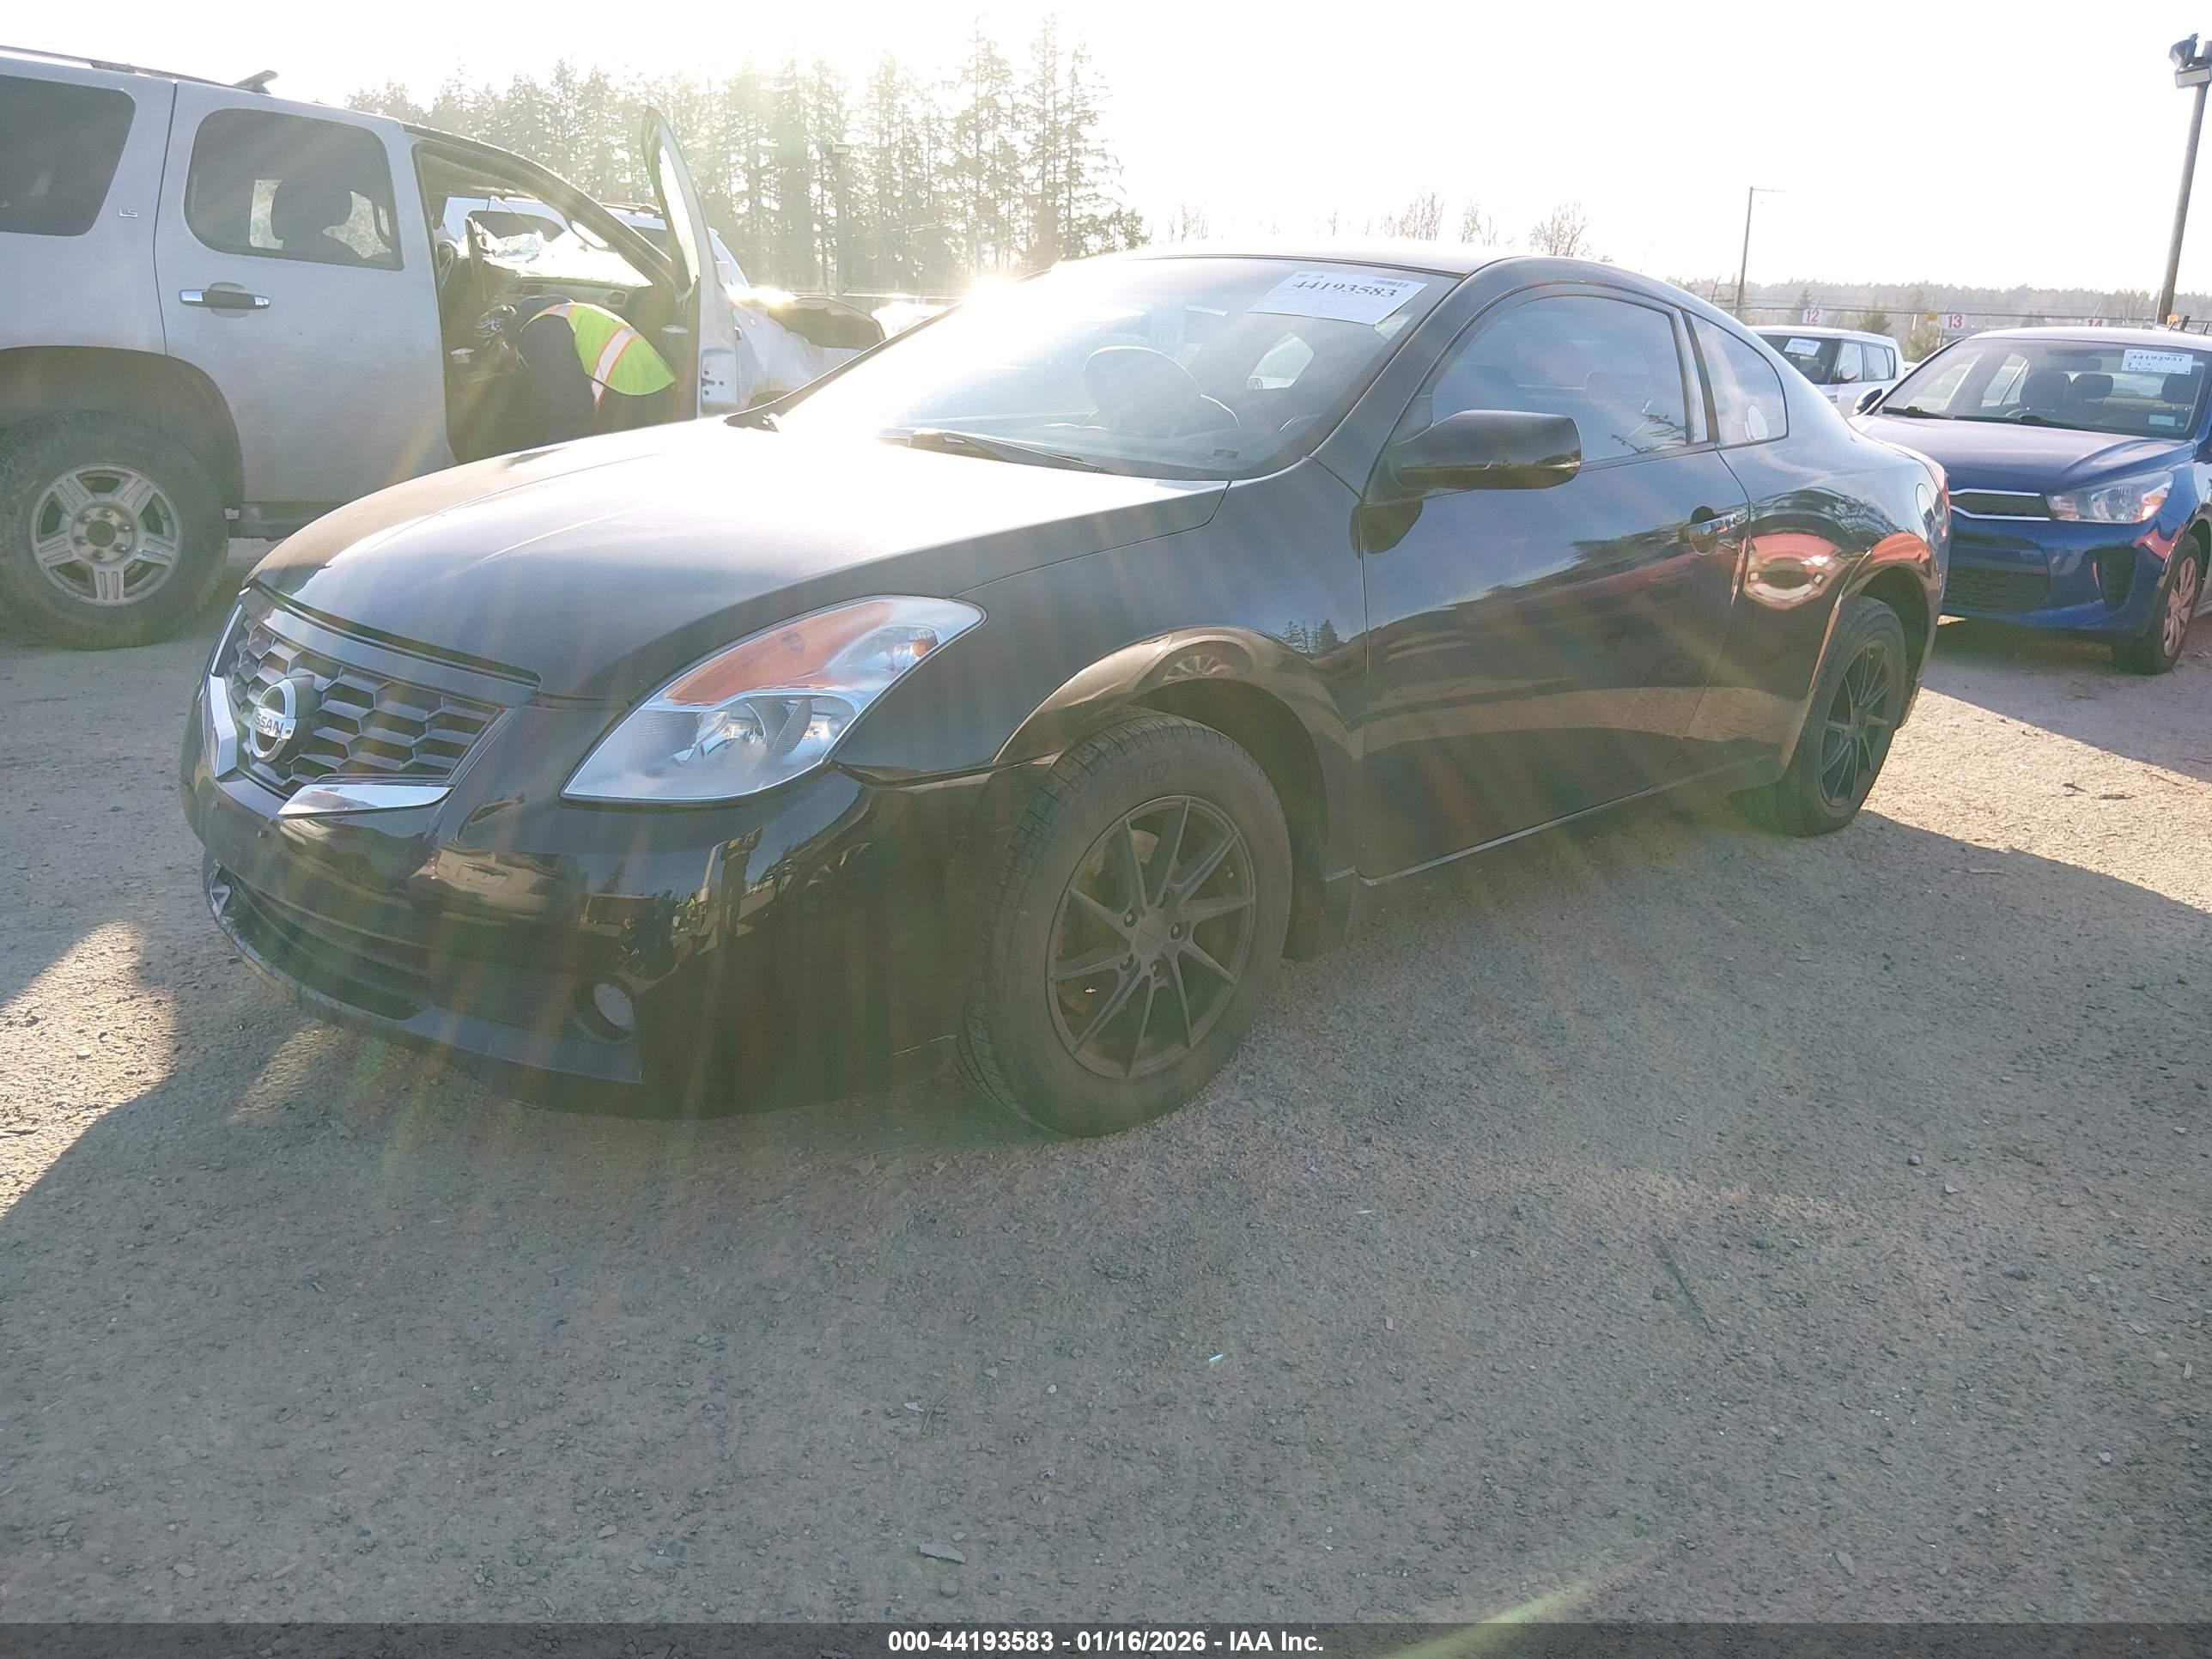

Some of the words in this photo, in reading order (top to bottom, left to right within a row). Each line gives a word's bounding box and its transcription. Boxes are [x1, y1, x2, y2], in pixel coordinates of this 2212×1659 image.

[1291, 280, 1398, 297] 44193583
[1806, 309, 1820, 323] 12
[1947, 314, 1963, 329] 13
